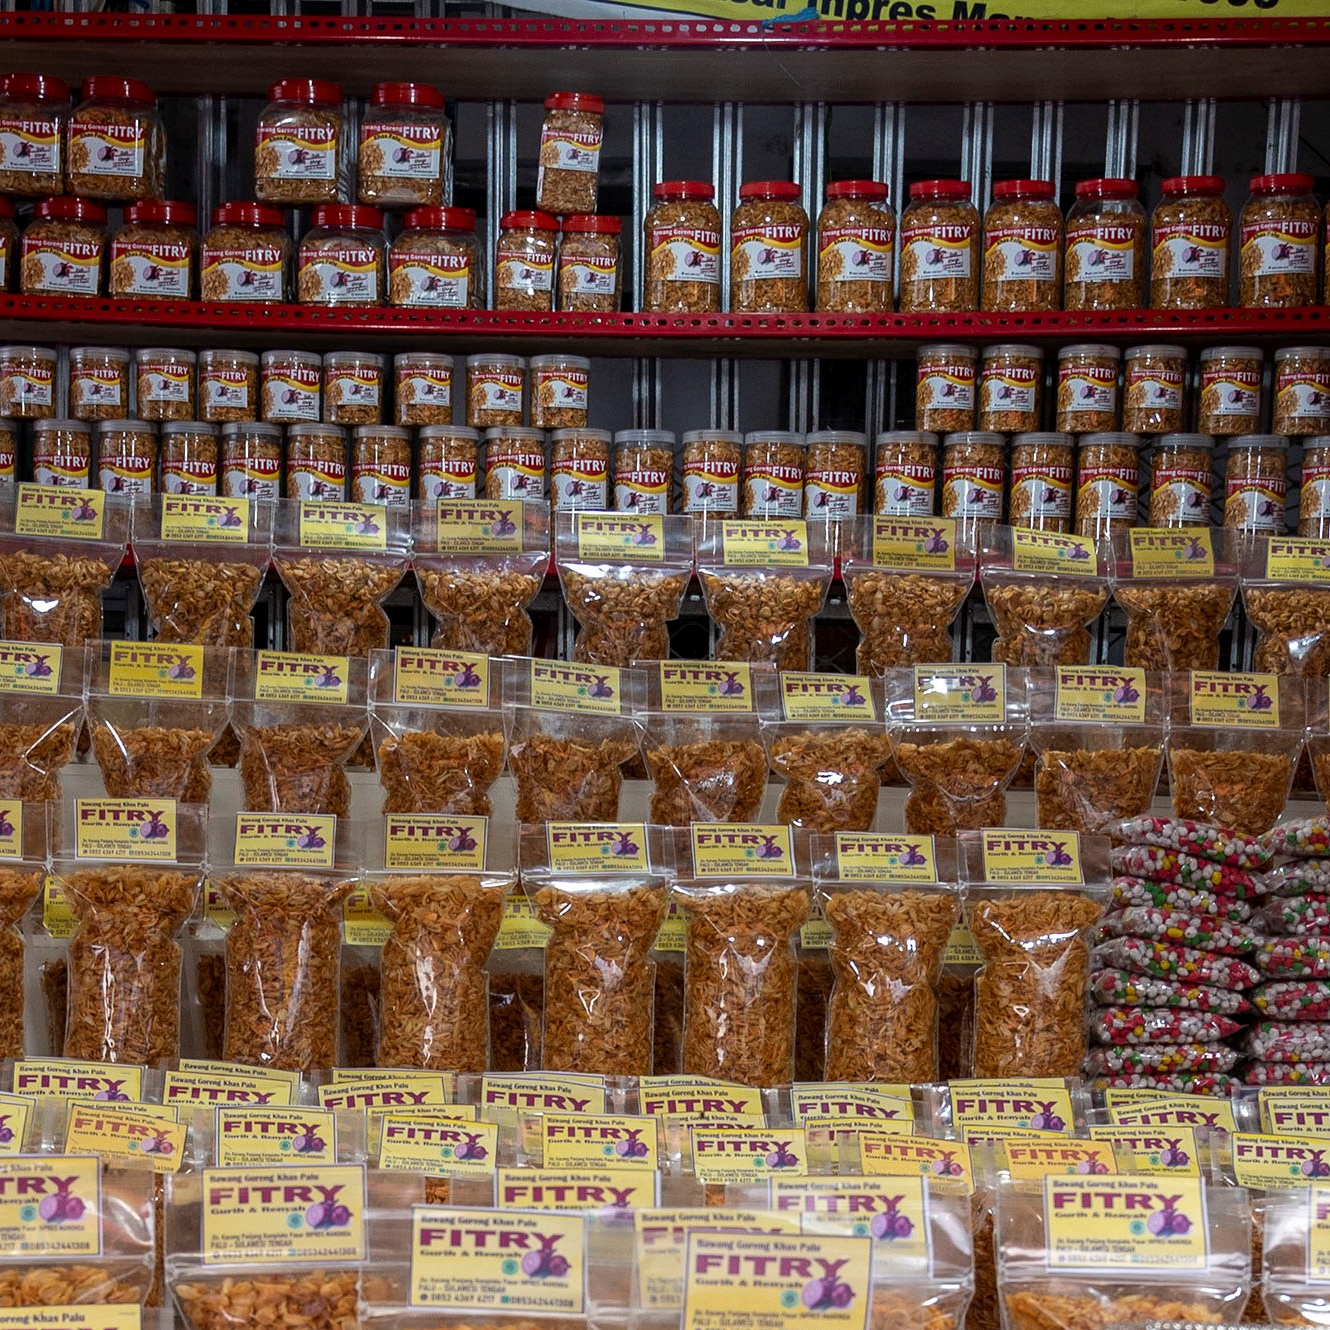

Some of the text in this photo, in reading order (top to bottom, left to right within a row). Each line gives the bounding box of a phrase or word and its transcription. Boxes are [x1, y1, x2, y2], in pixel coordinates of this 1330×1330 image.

[22, 121, 59, 135] FITRY
[297, 127, 335, 140] FITRY
[402, 126, 440, 139] FITRY
[765, 226, 801, 238] FITRY
[934, 226, 970, 238] FITRY
[1024, 228, 1057, 240] FITRY
[1096, 227, 1134, 239] FITRY
[1192, 225, 1226, 237] FITRY
[63, 242, 100, 256] FITRY
[152, 244, 189, 258] FITRY
[244, 249, 281, 261] FITRY
[338, 250, 376, 262] FITRY
[430, 255, 467, 268] FITRY
[527, 253, 553, 263] FITRY
[591, 256, 616, 266] FITRY
[1006, 367, 1035, 379] FITRY
[115, 457, 150, 469] FITRY
[182, 462, 216, 474] FITRY
[442, 461, 475, 473] FITRY
[704, 461, 738, 473] FITRY
[822, 471, 857, 484] FITRY
[21, 494, 95, 507] FITRY
[166, 502, 239, 514] FITRY
[441, 509, 513, 520] FITRY
[582, 522, 653, 532] FITRY
[876, 525, 946, 538] FITRY
[1134, 536, 1201, 546] FITRY
[114, 652, 193, 664] FITRY
[400, 657, 478, 672] FITRY
[534, 668, 610, 684] FITRY
[664, 670, 740, 681] FITRY
[1061, 675, 1136, 687] FITRY
[1194, 682, 1268, 694] FITRY
[81, 809, 165, 821] FITRY
[240, 824, 324, 835] FITRY
[390, 826, 474, 837] FITRY
[552, 832, 634, 842] FITRY
[697, 834, 778, 844] FITRY
[987, 841, 1068, 851] FITRY
[18, 1074, 127, 1091] FITRY
[169, 1086, 276, 1103] FITRY
[487, 1090, 592, 1110] FITRY
[956, 1100, 1057, 1113] FITRY
[224, 1121, 321, 1134] FITRY
[547, 1126, 644, 1140] FITRY
[387, 1126, 486, 1143] FITRY
[696, 1141, 793, 1152] FITRY
[1236, 1145, 1328, 1160] FITRY
[210, 1184, 345, 1205] FITRY
[504, 1186, 638, 1202] FITRY
[1053, 1192, 1184, 1210] FITRY
[420, 1228, 565, 1250] FITRY
[695, 1254, 851, 1278] FITRY
